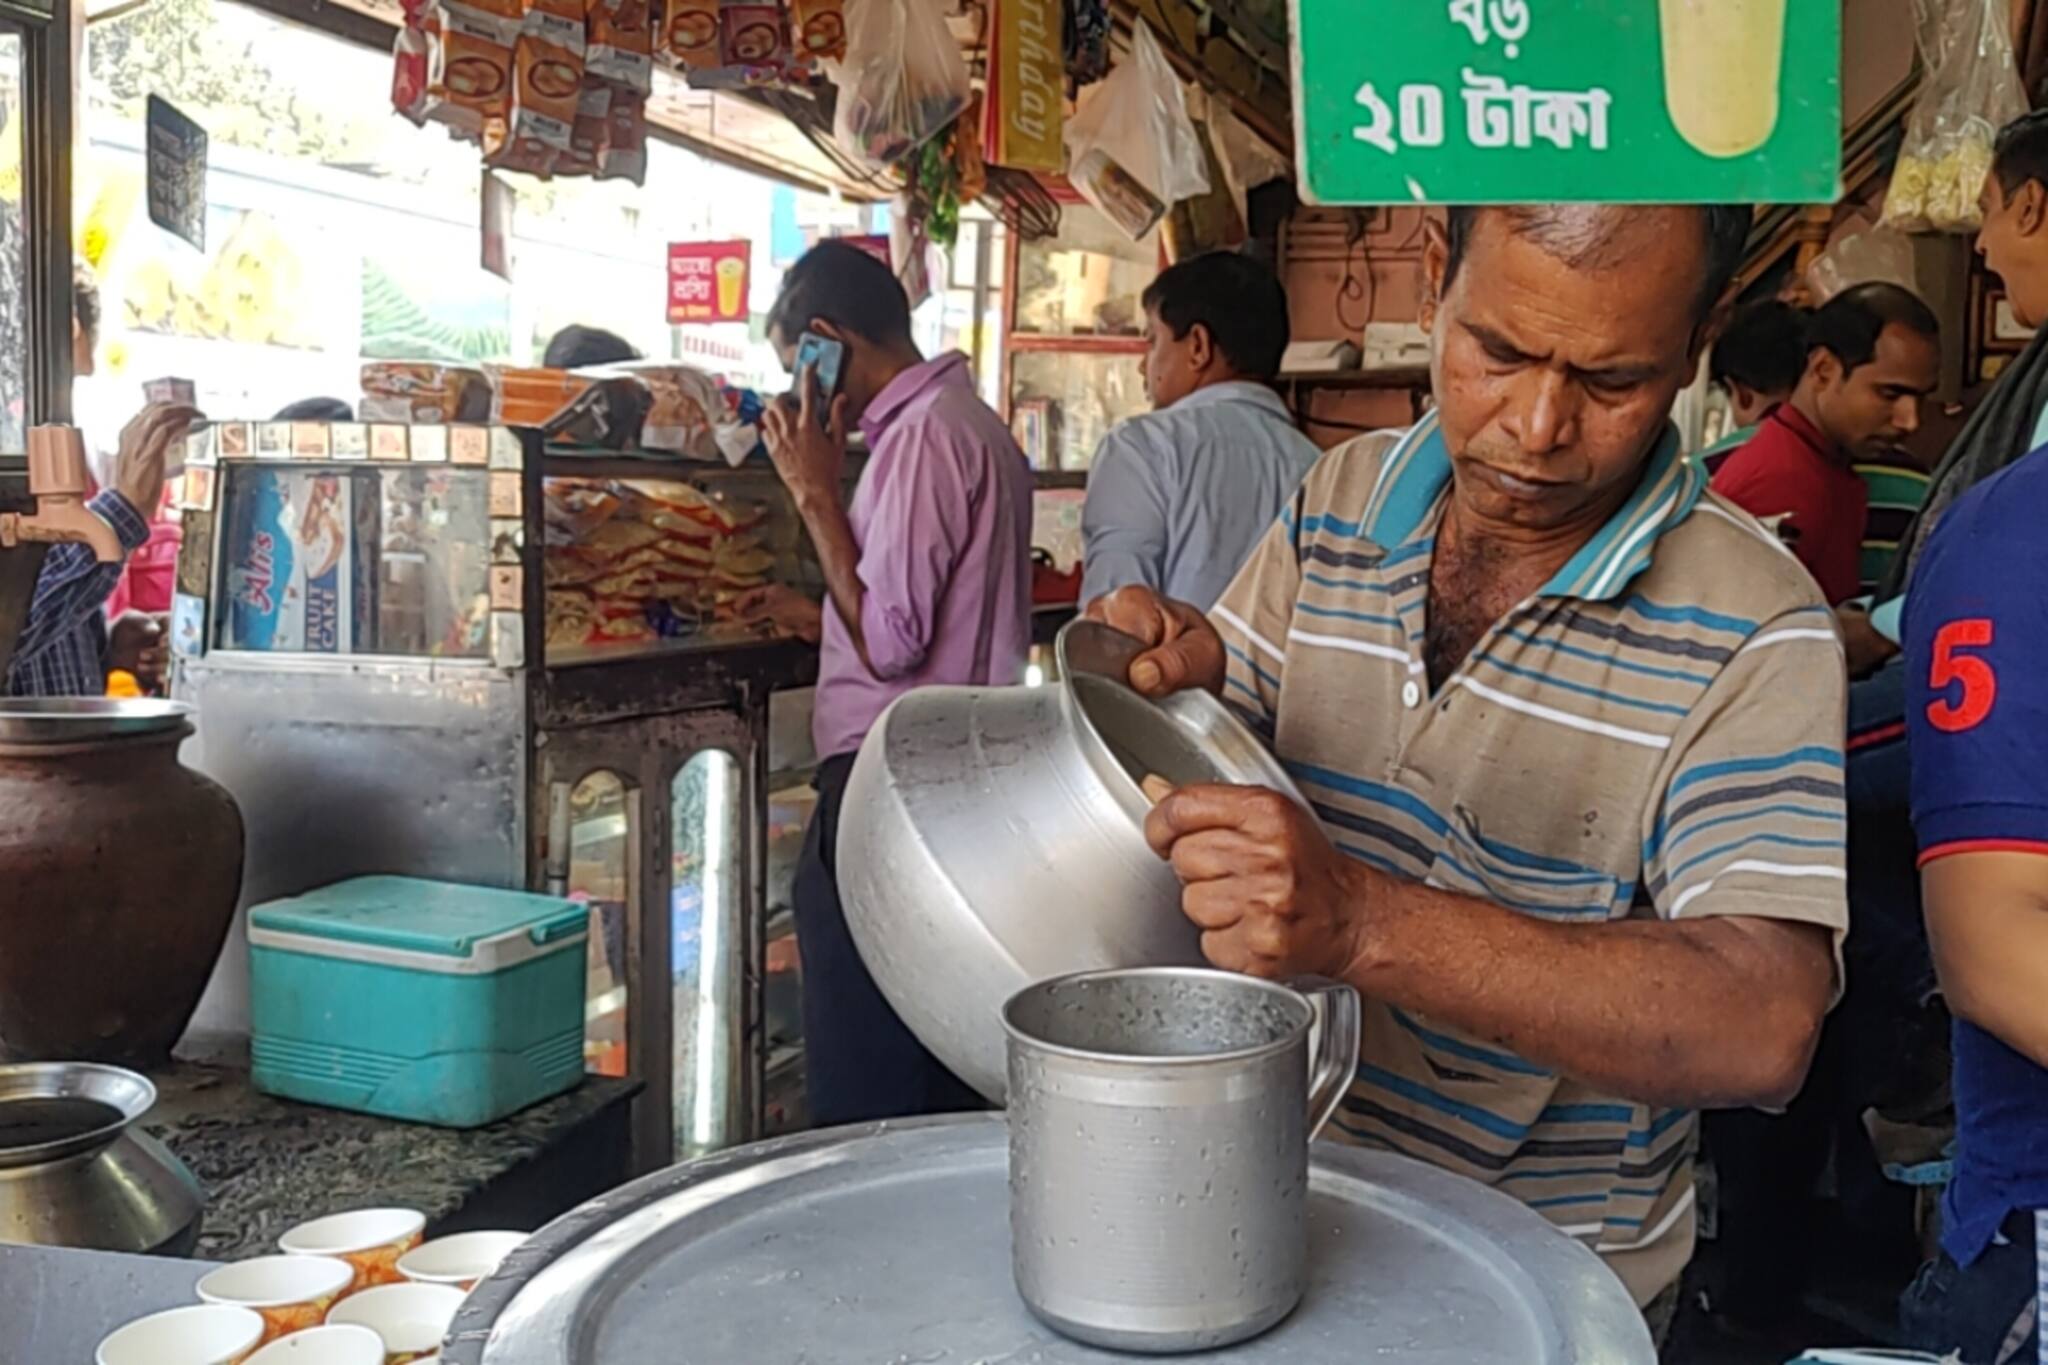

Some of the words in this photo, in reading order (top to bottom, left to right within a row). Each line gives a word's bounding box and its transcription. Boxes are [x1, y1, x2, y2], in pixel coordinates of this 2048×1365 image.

[1011, 0, 1053, 141] rthday
[1352, 82, 1445, 155] ২০
[1459, 66, 1612, 150] টাকা
[1926, 618, 1996, 733] 5
